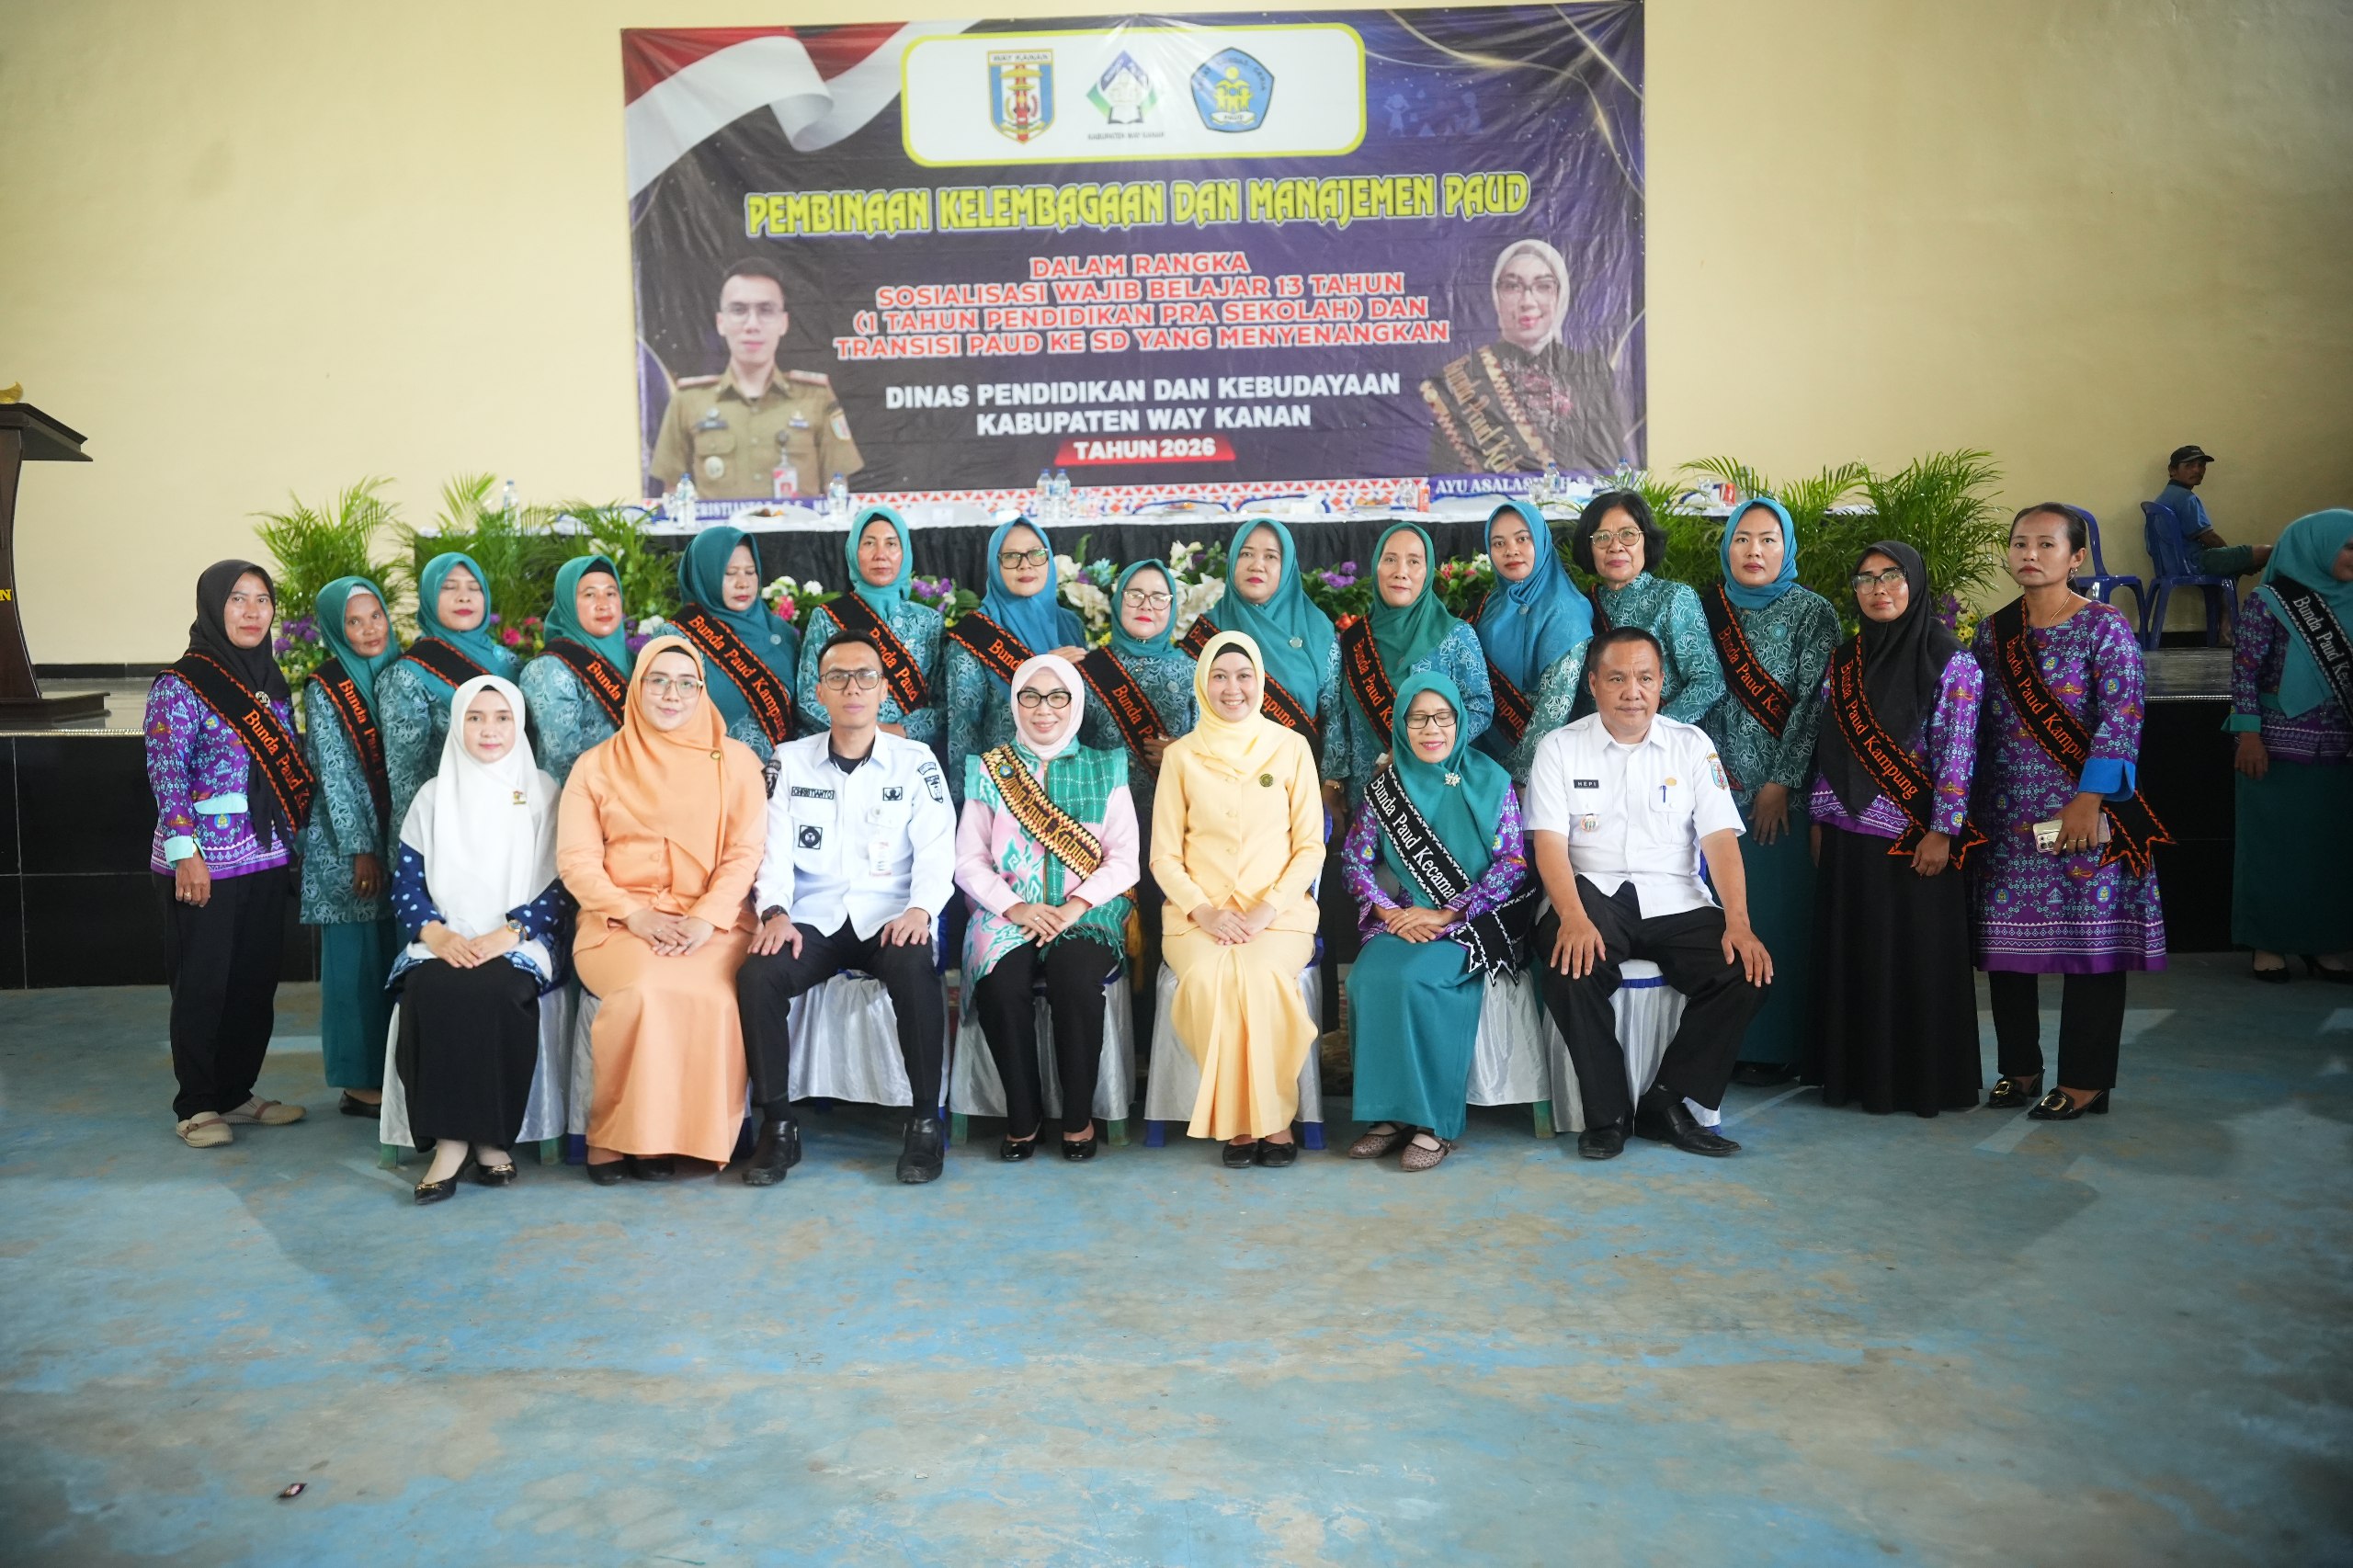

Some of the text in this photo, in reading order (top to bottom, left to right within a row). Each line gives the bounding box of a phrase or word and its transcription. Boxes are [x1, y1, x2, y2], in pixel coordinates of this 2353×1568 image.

[745, 171, 1530, 237] PEMBINAAN KELEMBAGAAN DAN MANAJEMEN PAUD
[1030, 251, 1250, 279] DALAM RANGKA
[876, 272, 1404, 308] SOSIALISASI WAJIB BELAJAR 13 TAHUN
[853, 295, 1429, 335] (1 TAHUN PENDIDIKAN PRA SEKOLAH) DAN
[833, 319, 1449, 360] TRANSISI PAUD KE SD YANG MENYENANGKAN
[885, 373, 1400, 409] DINAS PENDIDIKAN DAN KEBUDAYAAN
[977, 404, 1311, 437] KABUPATEN WAY KANAN
[1074, 437, 1216, 460] TAHUN 2026
[1436, 479, 1468, 494] AYU
[2292, 596, 2325, 632] Bunda
[2316, 631, 2345, 662] Paud
[586, 660, 620, 701] Bunda
[688, 615, 787, 741] Bunda Paud Kampung
[1353, 638, 1371, 676] Bunda
[1362, 673, 1386, 707] Paud
[1718, 625, 1741, 665] Bunda
[1735, 662, 1767, 698] Paud
[2006, 634, 2023, 677] Bunda
[2018, 676, 2049, 715] Paud
[338, 679, 367, 724] Bunda
[894, 665, 919, 702] Paud
[1111, 684, 1142, 725] Bunda
[242, 709, 279, 756] Bunda
[276, 753, 304, 791] Paud
[1840, 659, 1919, 801] Bunda Paud Kampung
[1370, 773, 1396, 817] Bunda
[1392, 812, 1422, 850] Paud
